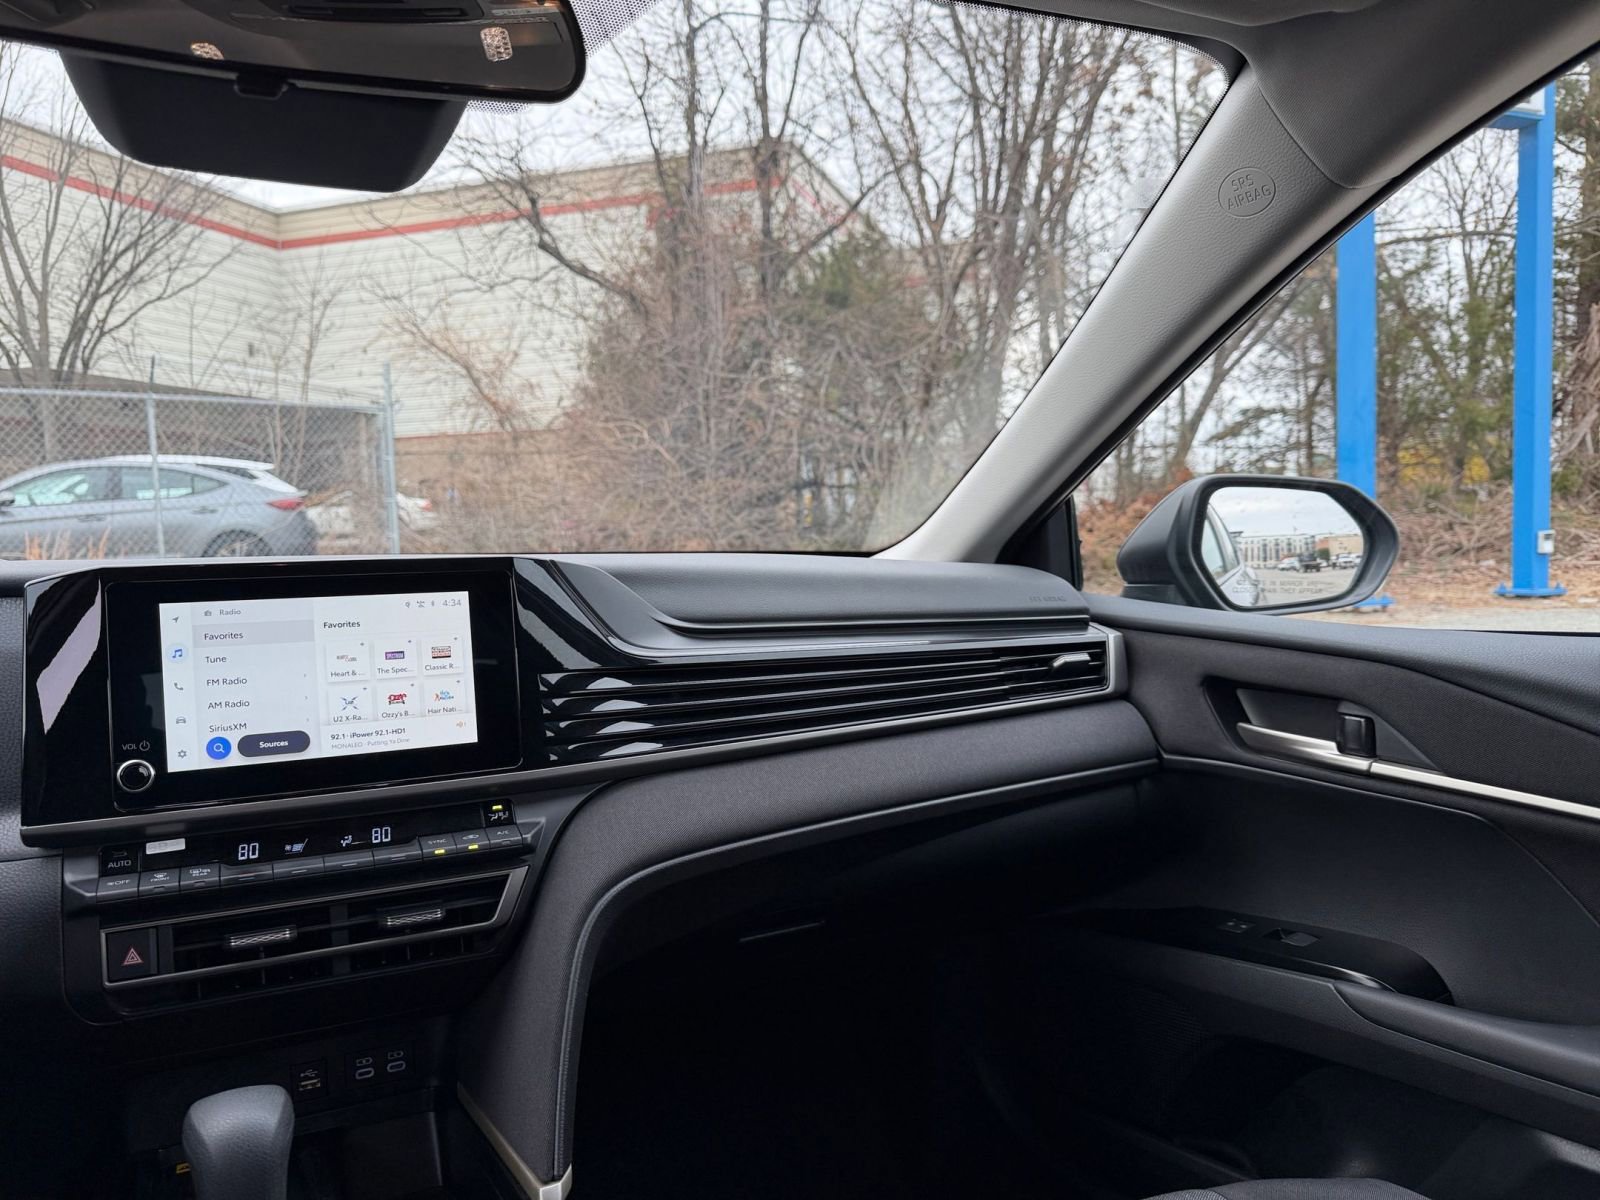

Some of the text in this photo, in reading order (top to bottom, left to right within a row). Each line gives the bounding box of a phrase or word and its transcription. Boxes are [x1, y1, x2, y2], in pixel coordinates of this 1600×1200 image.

[323, 620, 361, 629] Favorites
[204, 631, 244, 641] Favorites
[205, 656, 227, 664] Tune
[330, 670, 350, 678] Heart
[377, 667, 390, 675] The
[206, 677, 248, 687] FM Radio
[207, 700, 250, 710] AM Radio
[381, 711, 403, 719] Ozzy's
[427, 707, 441, 715] Hair
[208, 723, 247, 733] SiriusXM
[374, 728, 406, 737] 92.1-HD1
[121, 743, 138, 751] VOL
[259, 740, 289, 749] Sources
[371, 826, 391, 843] 80
[238, 842, 259, 861] 80
[107, 859, 132, 869] AUTO
